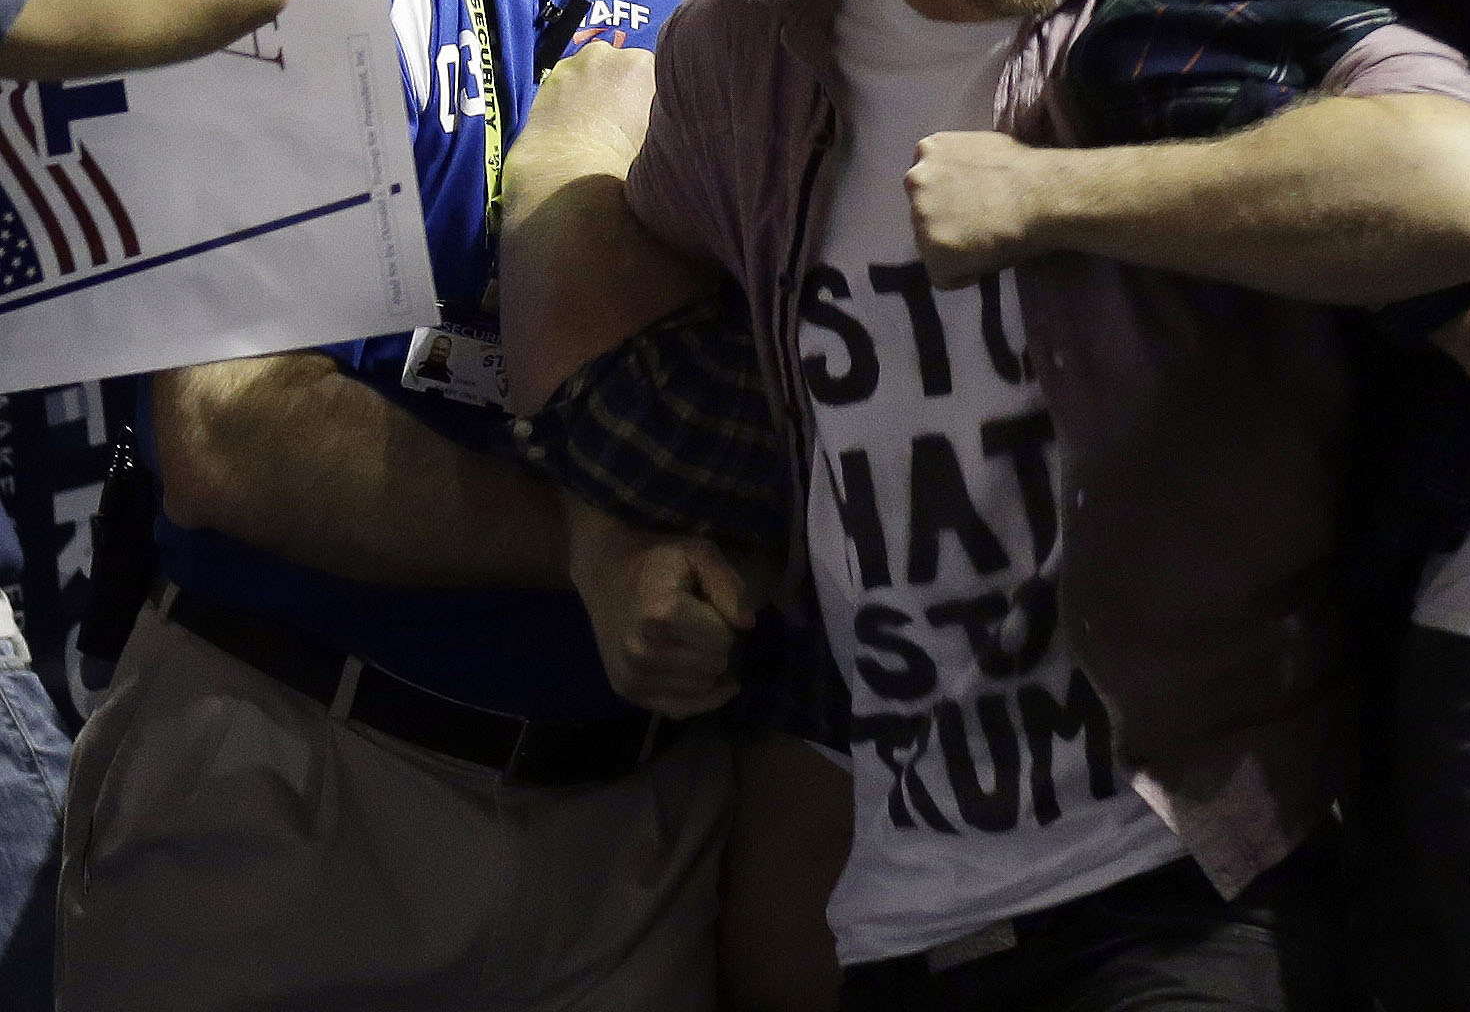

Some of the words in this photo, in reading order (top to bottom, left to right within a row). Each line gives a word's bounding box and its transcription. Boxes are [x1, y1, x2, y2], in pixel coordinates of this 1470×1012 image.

[579, 0, 650, 30] AFF
[799, 261, 1037, 406] STO
[854, 576, 1060, 701] STO
